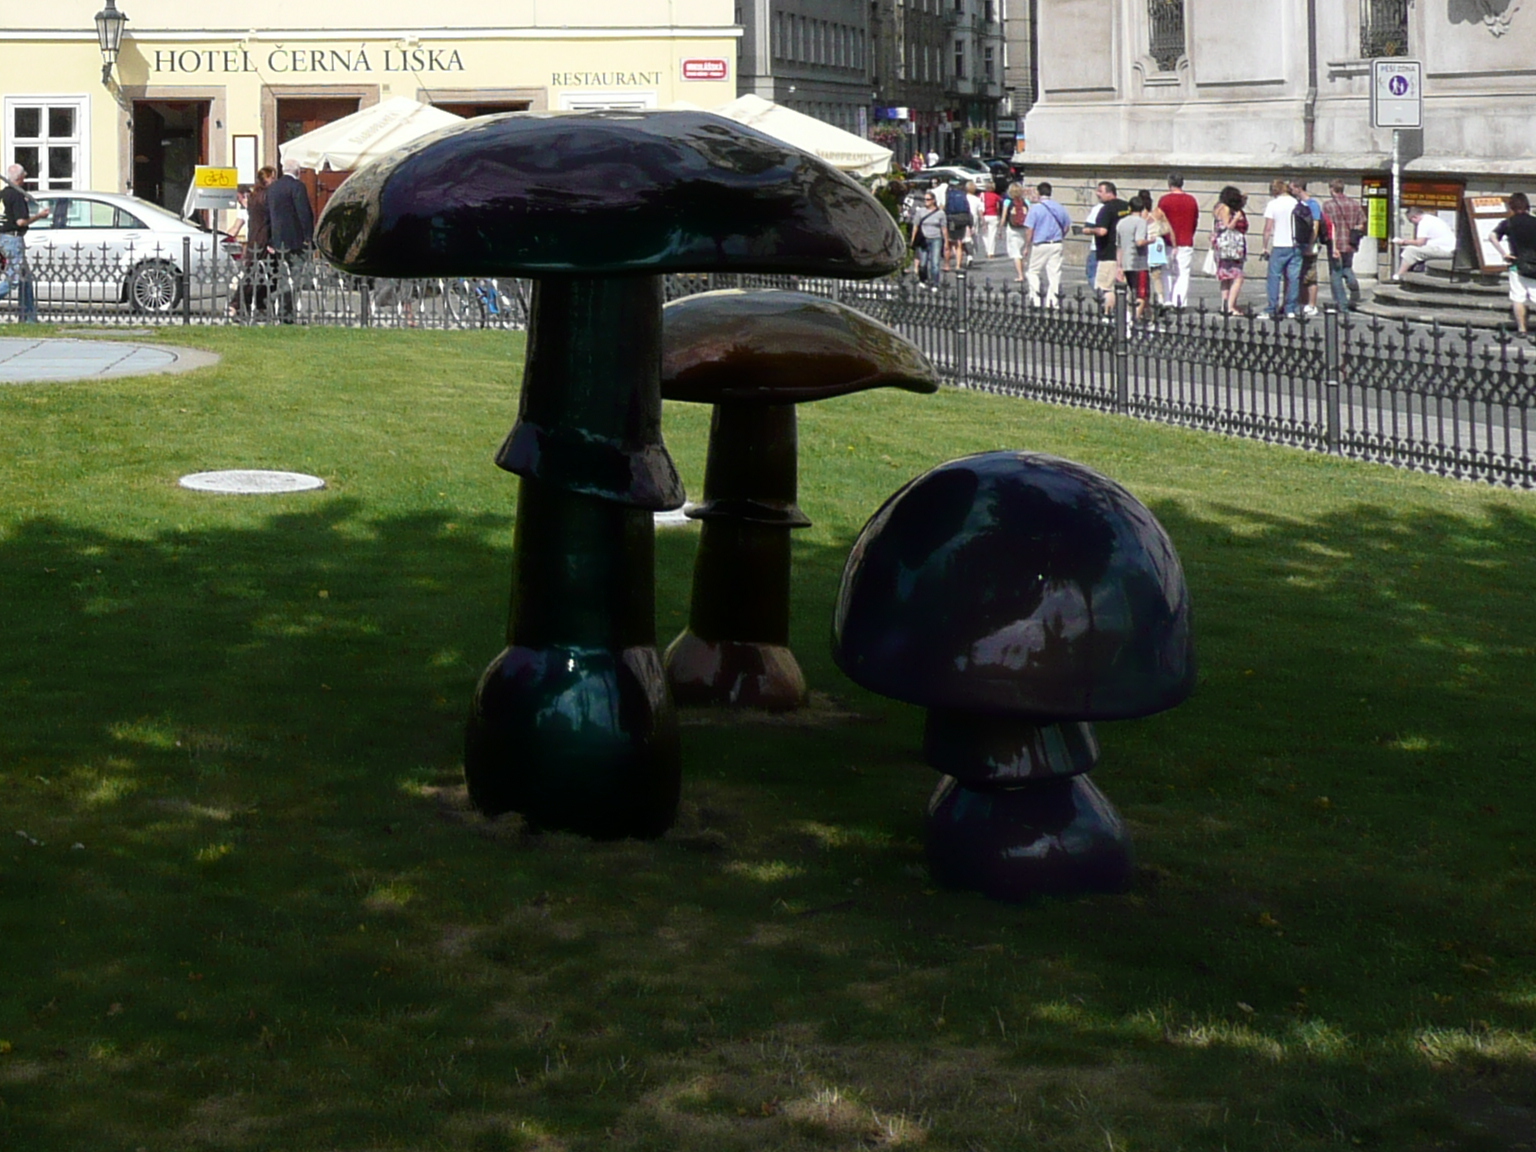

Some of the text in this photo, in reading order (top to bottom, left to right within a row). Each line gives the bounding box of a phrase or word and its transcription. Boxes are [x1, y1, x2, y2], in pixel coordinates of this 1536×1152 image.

[154, 43, 465, 73] HOTEL ČERNÁ LIŠKA
[551, 71, 663, 86] RESTAURANT
